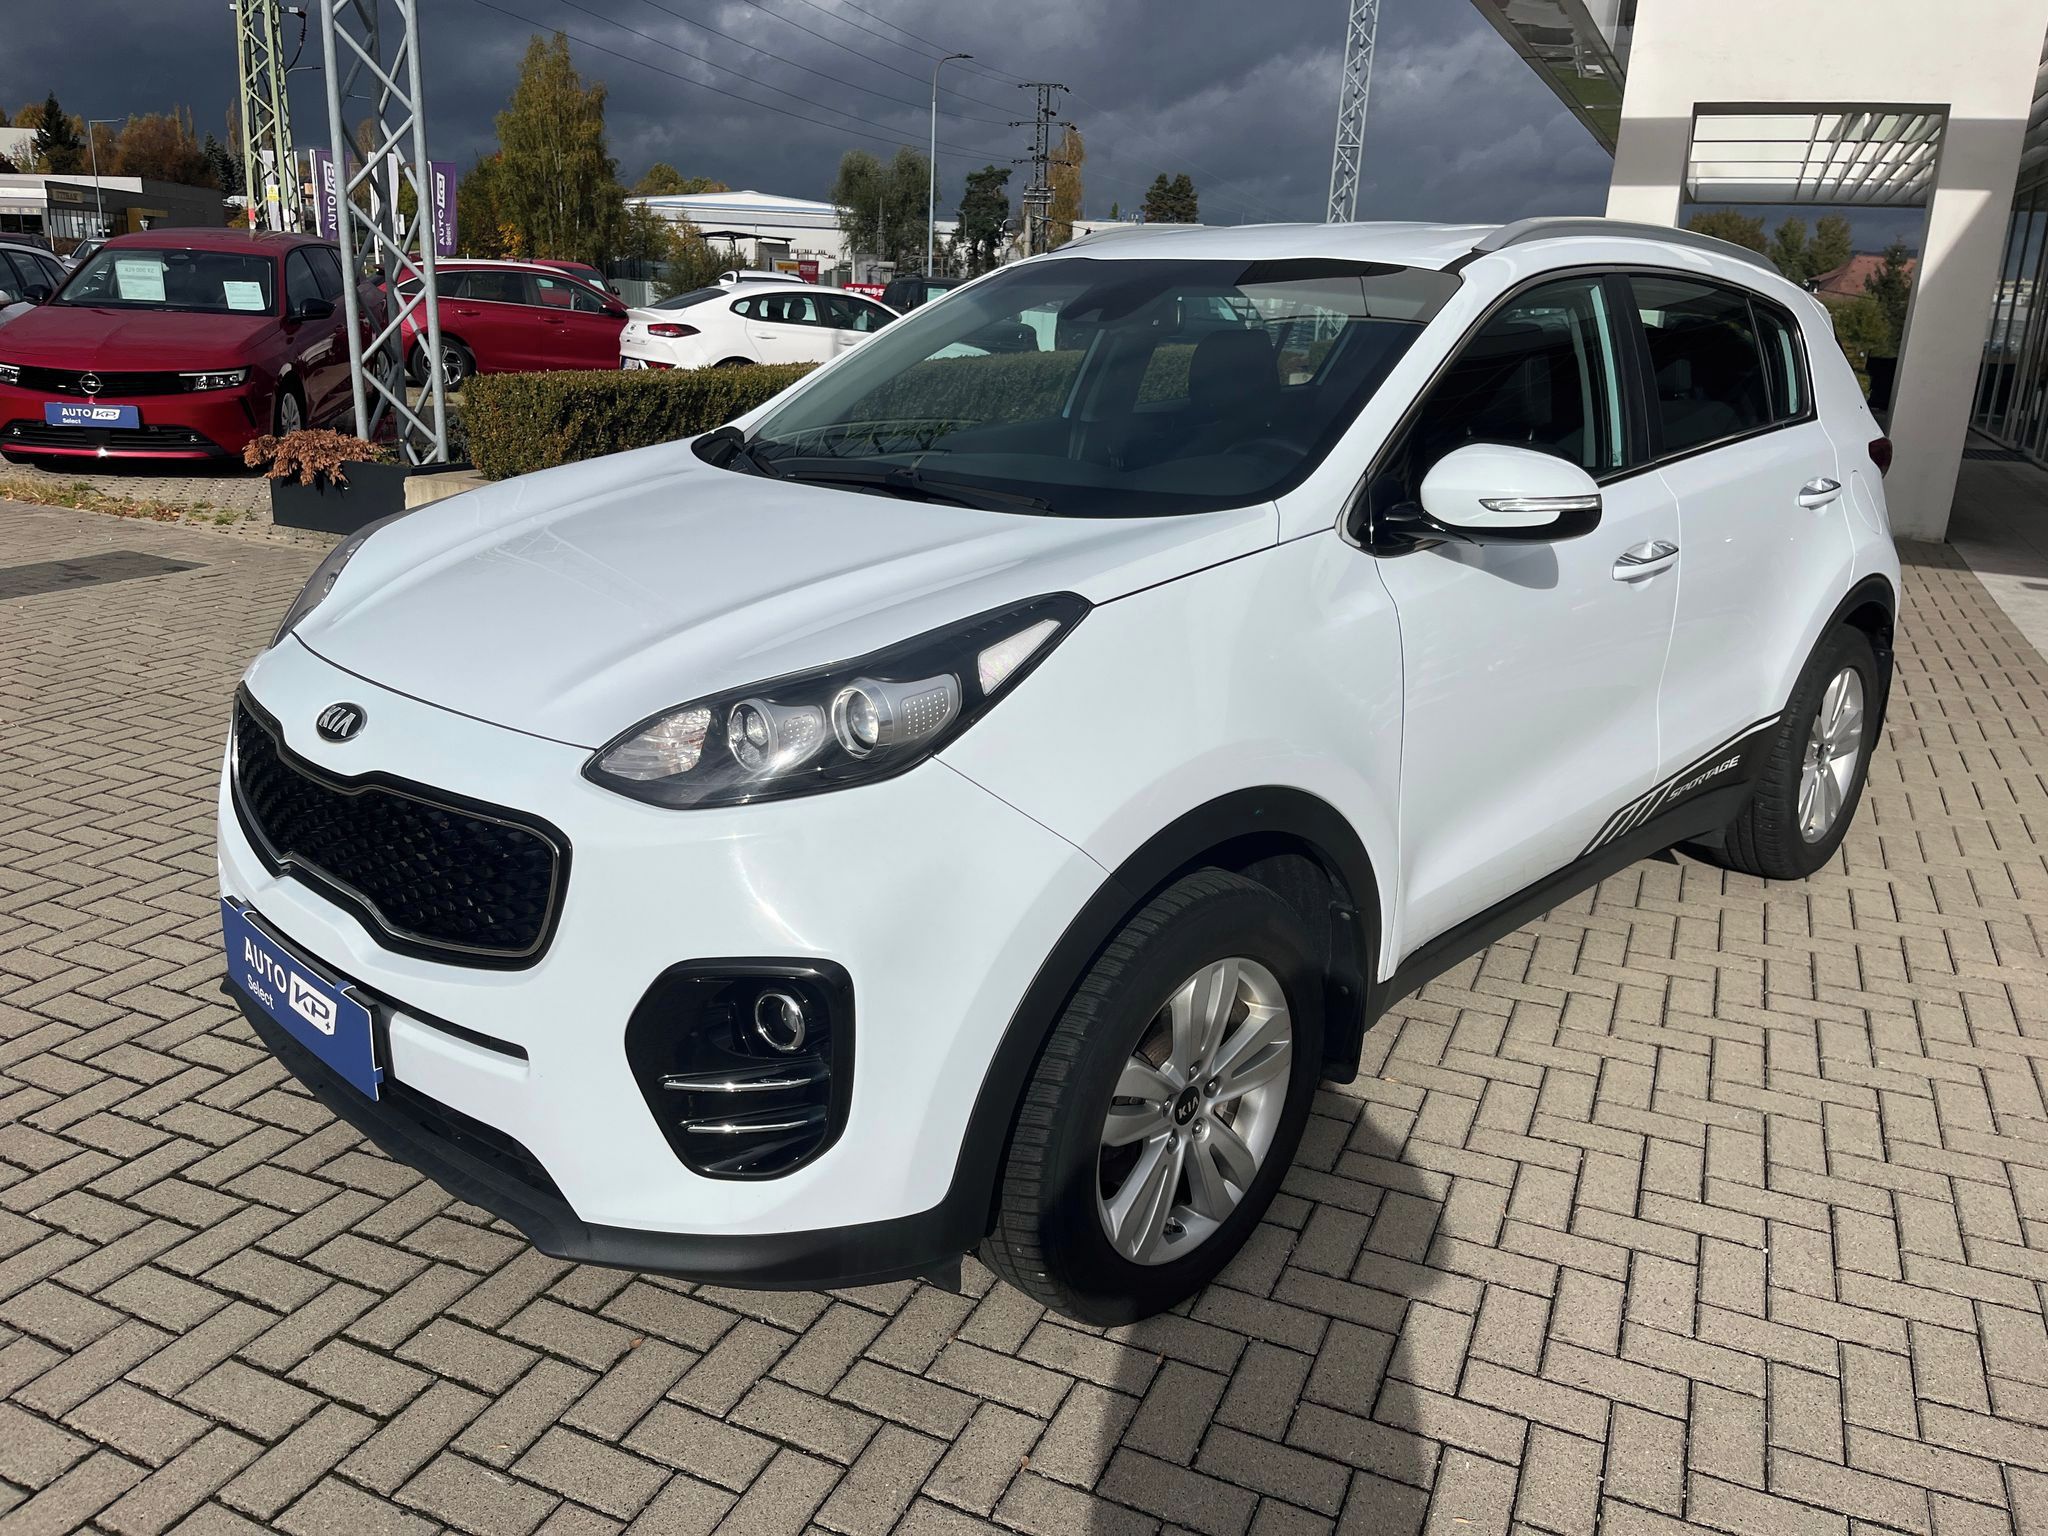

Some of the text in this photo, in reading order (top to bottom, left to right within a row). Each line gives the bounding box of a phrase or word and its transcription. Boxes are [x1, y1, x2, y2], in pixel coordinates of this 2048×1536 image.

[327, 195, 337, 231] AUTO
[437, 209, 445, 246] AUTO
[61, 407, 92, 417] AUTO
[318, 705, 357, 737] KIA
[1666, 754, 1741, 803] SPORTAGE
[244, 936, 287, 995] AUTO
[246, 973, 275, 1010] Select
[1177, 1096, 1199, 1119] KIA
